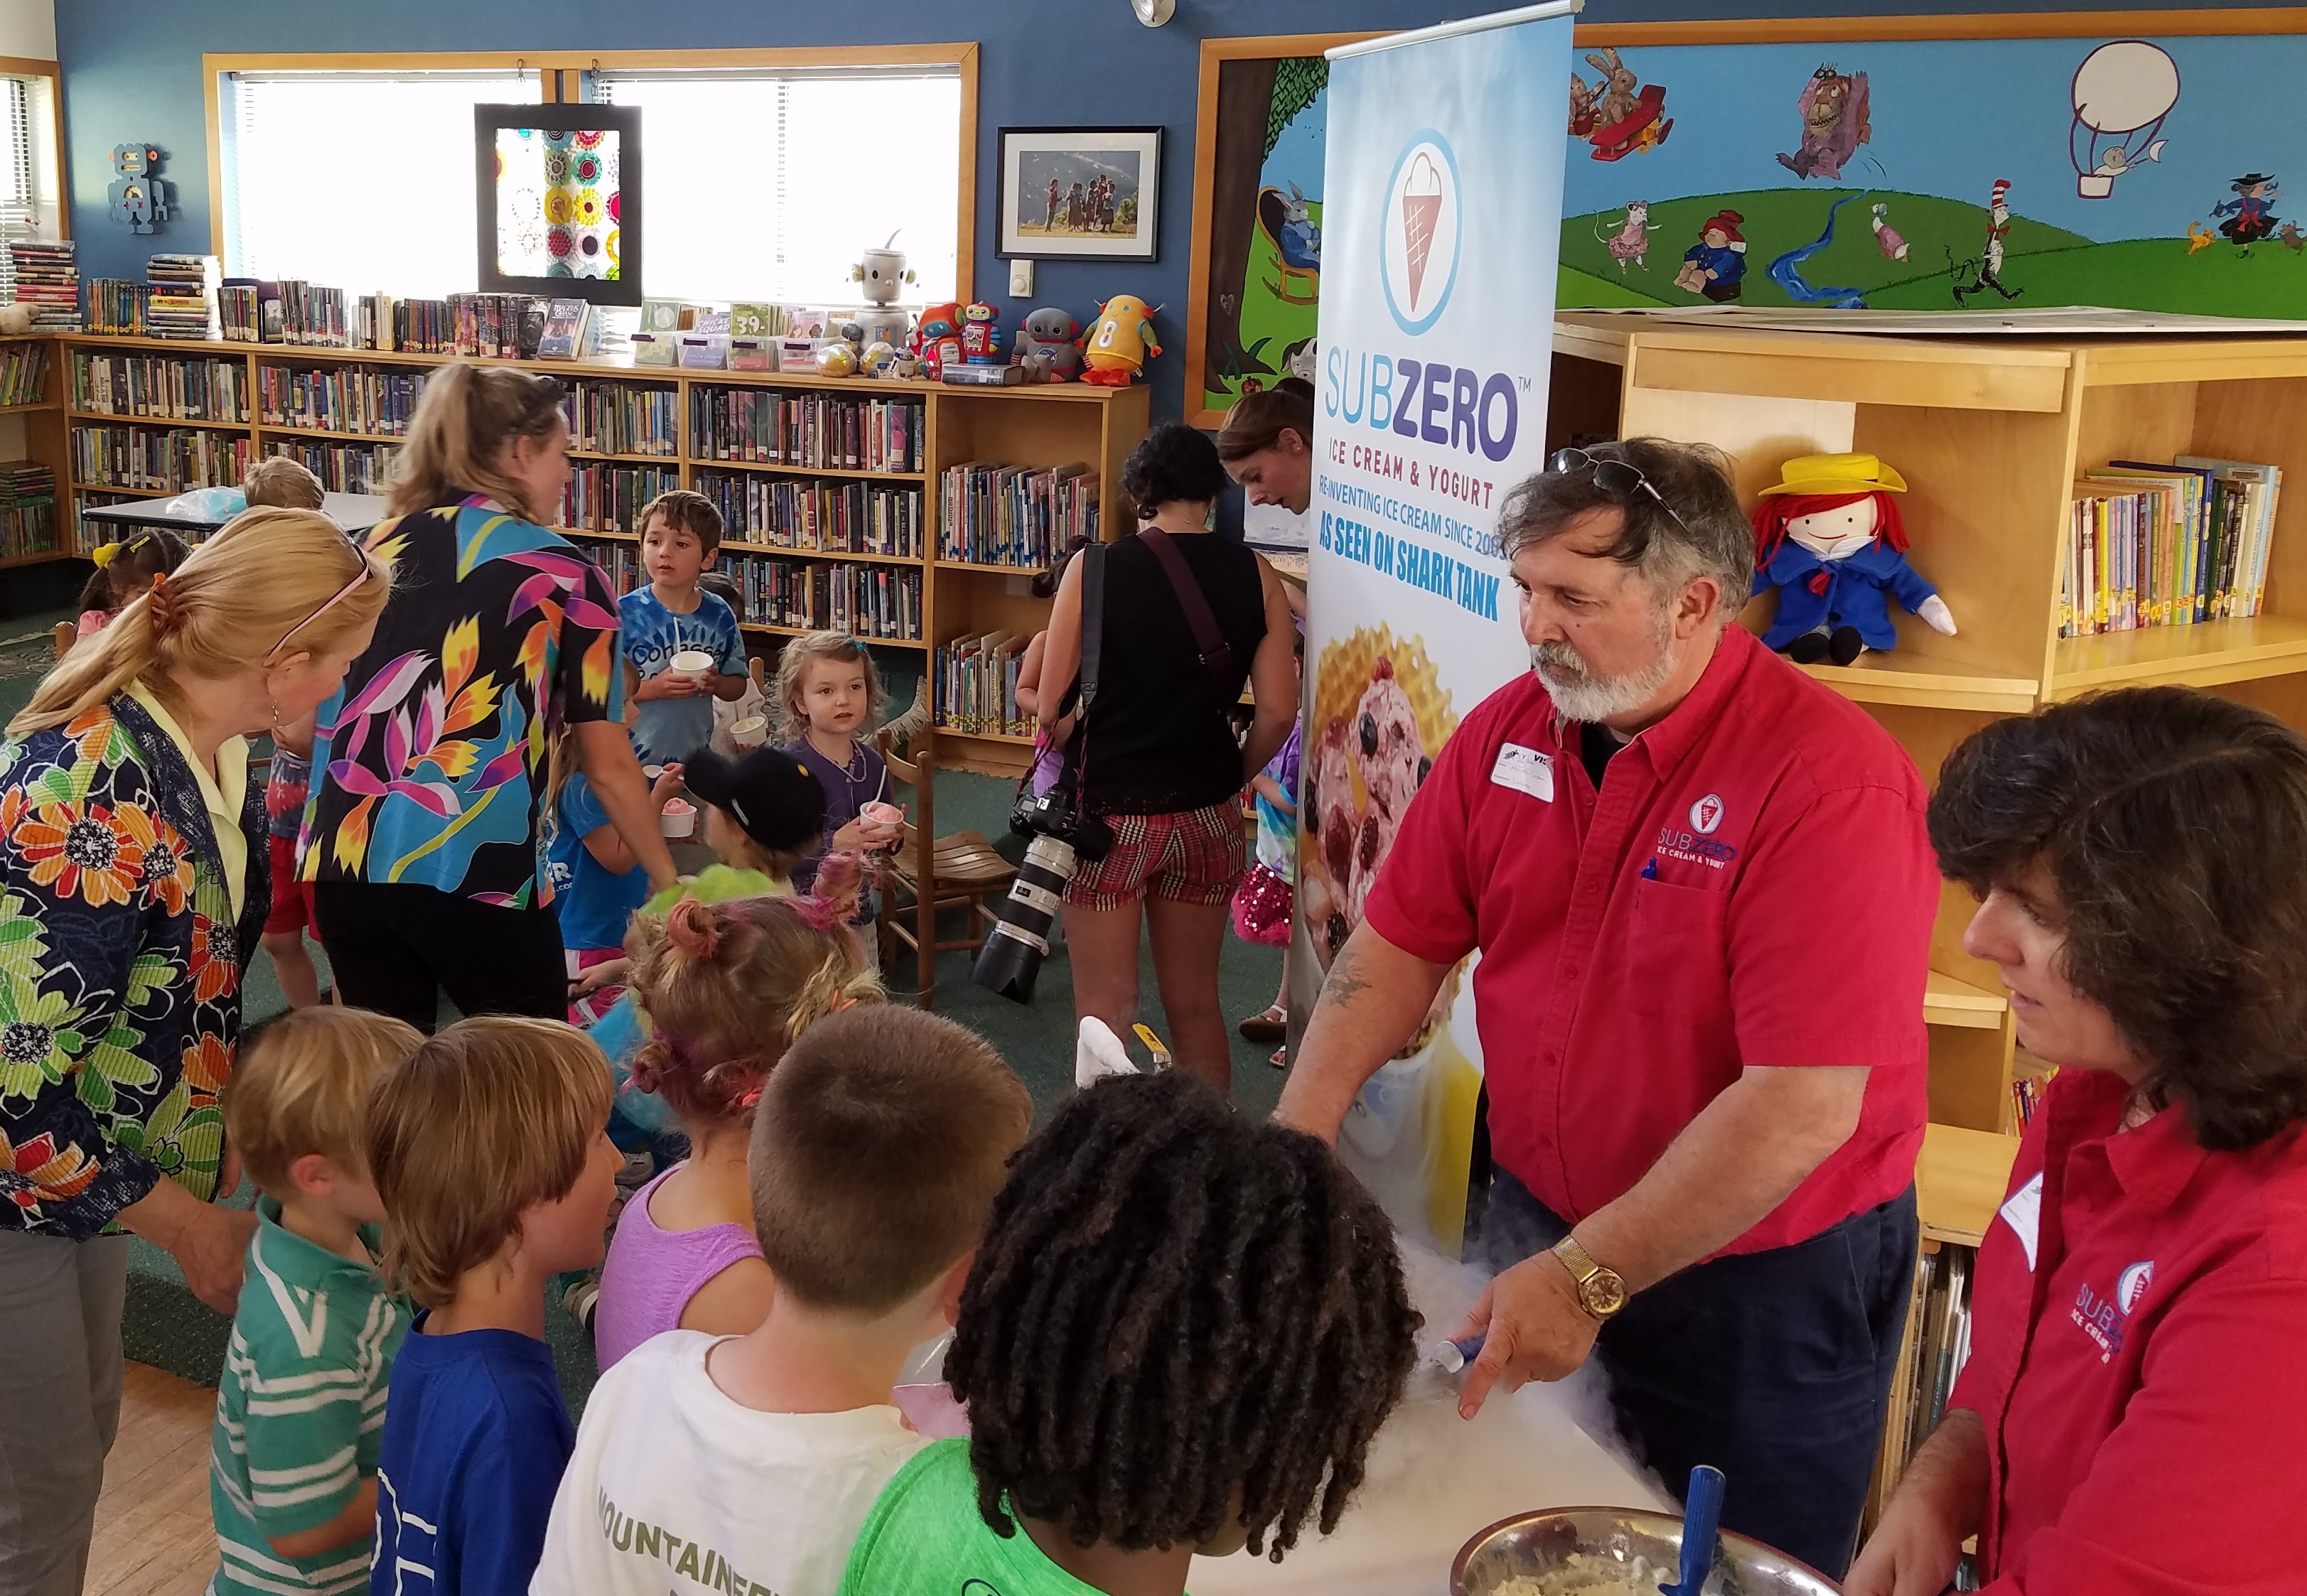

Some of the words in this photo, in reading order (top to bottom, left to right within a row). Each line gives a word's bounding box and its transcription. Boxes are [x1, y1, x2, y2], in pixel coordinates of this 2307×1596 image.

[697, 324, 730, 335] SQUAD
[1325, 345, 1518, 462] SUBZERO
[1328, 436, 1347, 465] ICE
[1353, 445, 1403, 482] CREAM
[1410, 460, 1419, 487] &
[1429, 464, 1493, 509] YOGURT
[1319, 474, 1381, 517] RE-INVENTING
[1382, 497, 1398, 520] ICE
[1400, 503, 1441, 537] CREAM
[1444, 517, 1473, 549] SINCE
[1475, 530, 1506, 561] 200
[1319, 509, 1332, 551] AS
[1335, 517, 1371, 566] SEEN
[1375, 531, 1394, 576] ON
[1397, 539, 1454, 600] SHARK
[1456, 561, 1501, 622] TANK
[1668, 848, 1696, 862] CREAM
[1696, 855, 1703, 864] &
[2071, 1307, 2085, 1327] ICE
[598, 1484, 780, 1596] MOUNTAINE
